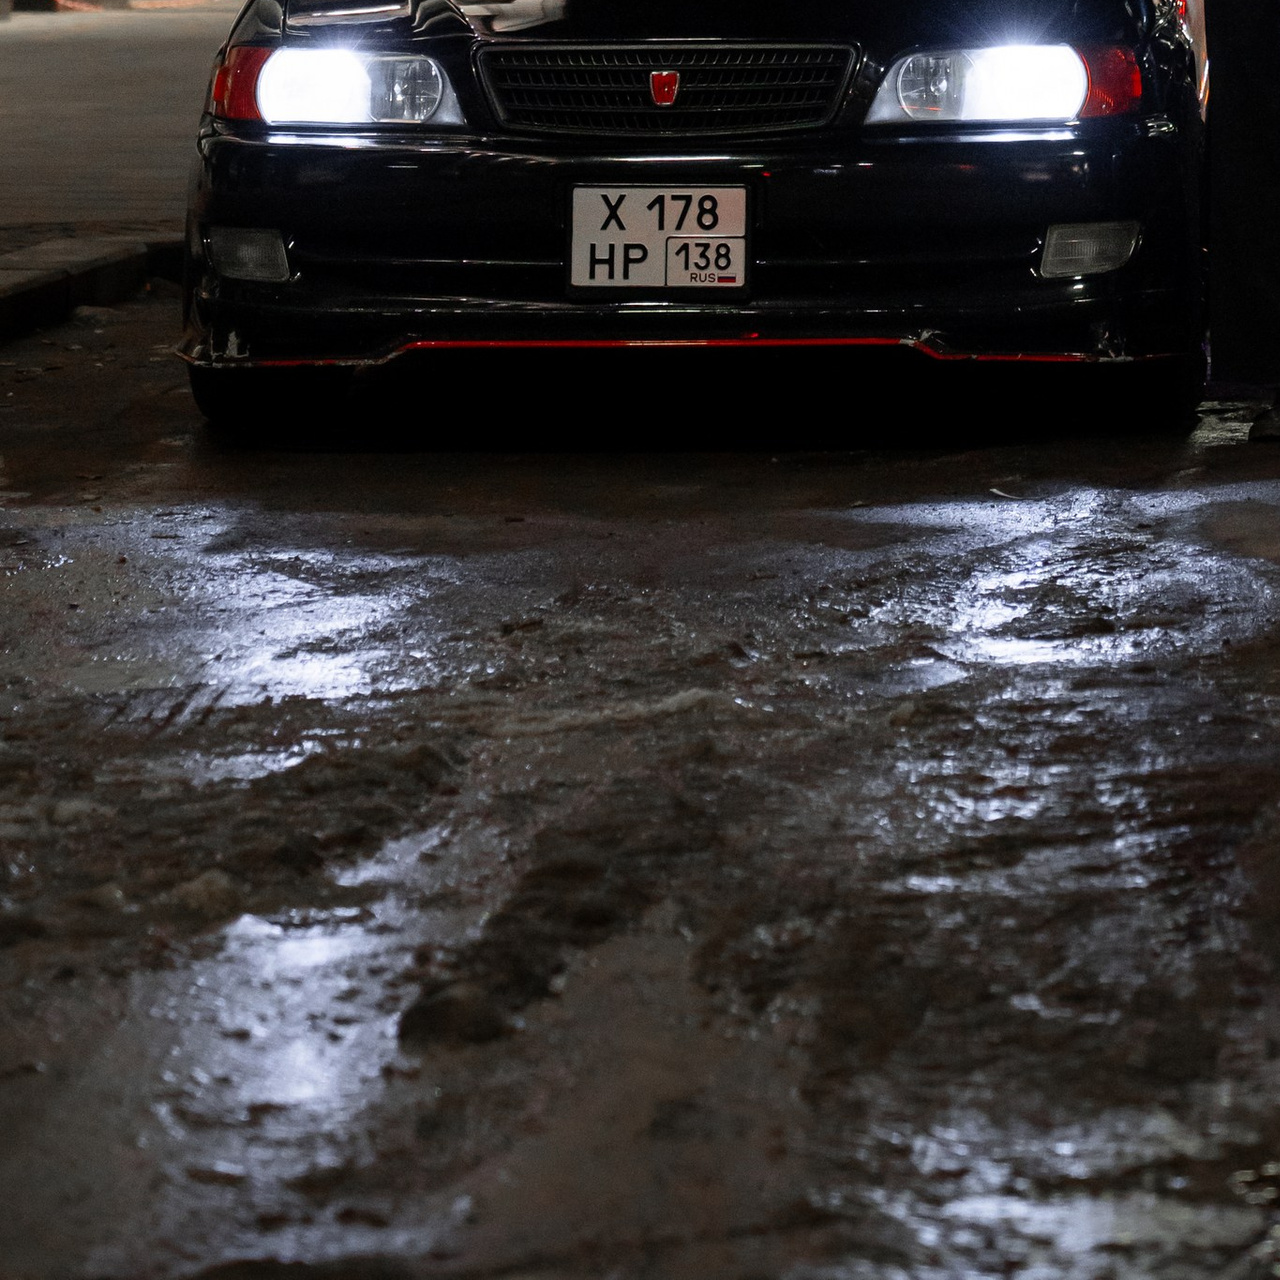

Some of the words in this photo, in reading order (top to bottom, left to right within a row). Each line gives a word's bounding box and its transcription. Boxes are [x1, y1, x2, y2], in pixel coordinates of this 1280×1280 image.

[646, 194, 719, 231] 178
[674, 242, 731, 271] 138
[690, 273, 716, 283] RUS
